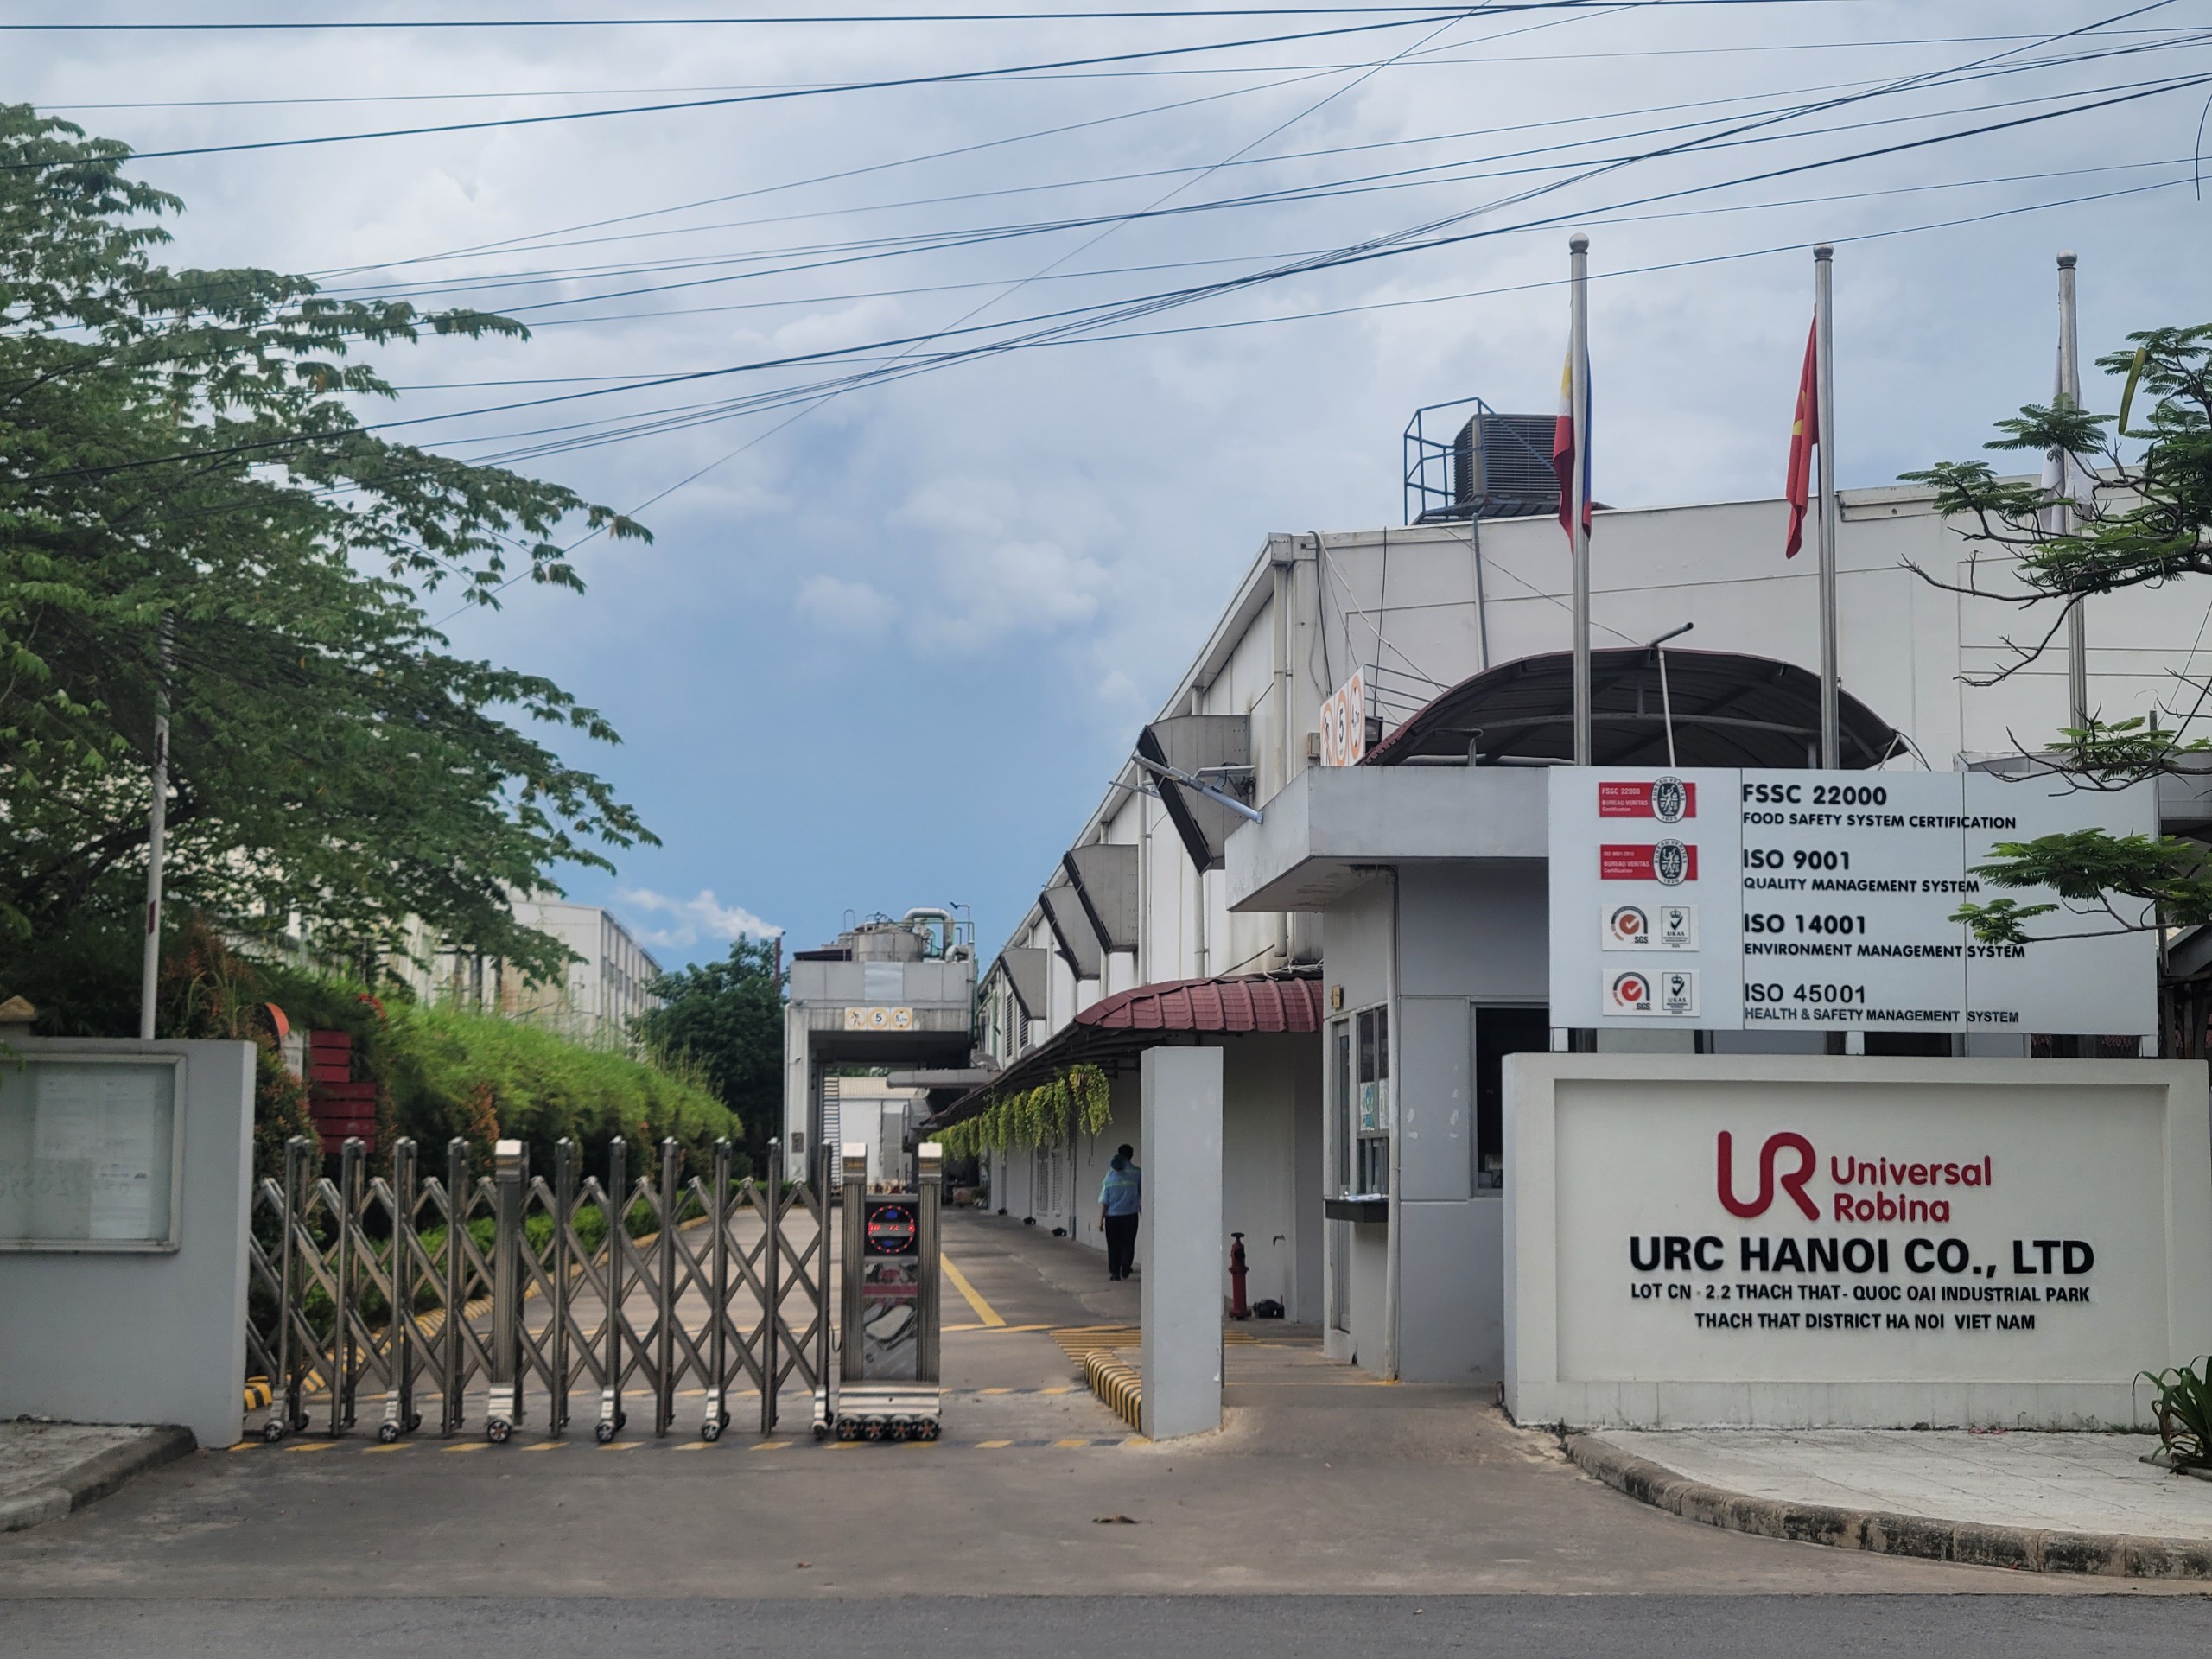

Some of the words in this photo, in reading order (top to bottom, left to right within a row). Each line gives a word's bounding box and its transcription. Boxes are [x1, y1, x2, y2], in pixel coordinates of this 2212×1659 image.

[1742, 784, 1802, 804] FSSC
[1812, 785, 1887, 805] 22000
[1743, 811, 1784, 825] FOOD
[1789, 813, 1842, 826] SAFETY
[1847, 815, 1904, 828] SYSTEM
[1909, 815, 2017, 829] CERTIFICATION
[1743, 849, 1784, 869] ISO
[1793, 850, 1849, 870] 9001
[1744, 877, 1807, 890] QUALITY
[1812, 879, 1917, 892] MANAGEMENT
[1922, 880, 1980, 893] SYSTEM
[1744, 913, 1785, 933] ISO
[1795, 914, 1865, 934] 14001
[1634, 935, 1649, 944] SGS
[1744, 943, 1852, 957] ENVIRONMENT
[1857, 944, 1962, 957] MANAGEMENT
[1967, 945, 2025, 958] SYSTEM
[1744, 982, 1784, 1002] ISO
[1793, 983, 1865, 1003] 45001
[1636, 1002, 1651, 1011] SGS
[1745, 1007, 1797, 1020] HEALTH
[1801, 1009, 1811, 1020] &
[1813, 1008, 1863, 1022] SAFETY
[1866, 1009, 1960, 1023] MANAGEMENT
[1967, 1011, 2019, 1023] SYSTEM
[875, 1013, 882, 1023] 5
[1717, 1130, 1821, 1221] UR
[1830, 1155, 1991, 1187] Universal
[1834, 1190, 1950, 1223] Robina
[1630, 1236, 1724, 1272] URC
[1740, 1237, 1889, 1274] HANOI
[1904, 1238, 1997, 1279] CO.,
[2012, 1240, 2094, 1274] LTD
[1631, 1283, 1662, 1300] LOT
[1668, 1284, 1692, 1300] CN
[1736, 1284, 1793, 1300] THACH
[1853, 1285, 1902, 1301] QUOC
[1906, 1286, 1936, 1301] OAI
[1942, 1287, 2041, 1303] INDUSTRIAL
[2045, 1287, 2090, 1303] PARK
[1694, 1313, 1753, 1329] THACH
[1758, 1313, 1801, 1329] THAT
[1805, 1313, 1882, 1330] DISTRICT
[1886, 1314, 1910, 1330] HA
[1915, 1314, 1945, 1330] NOI
[1954, 1314, 1992, 1331] VIET
[1996, 1314, 2036, 1331] NAM
